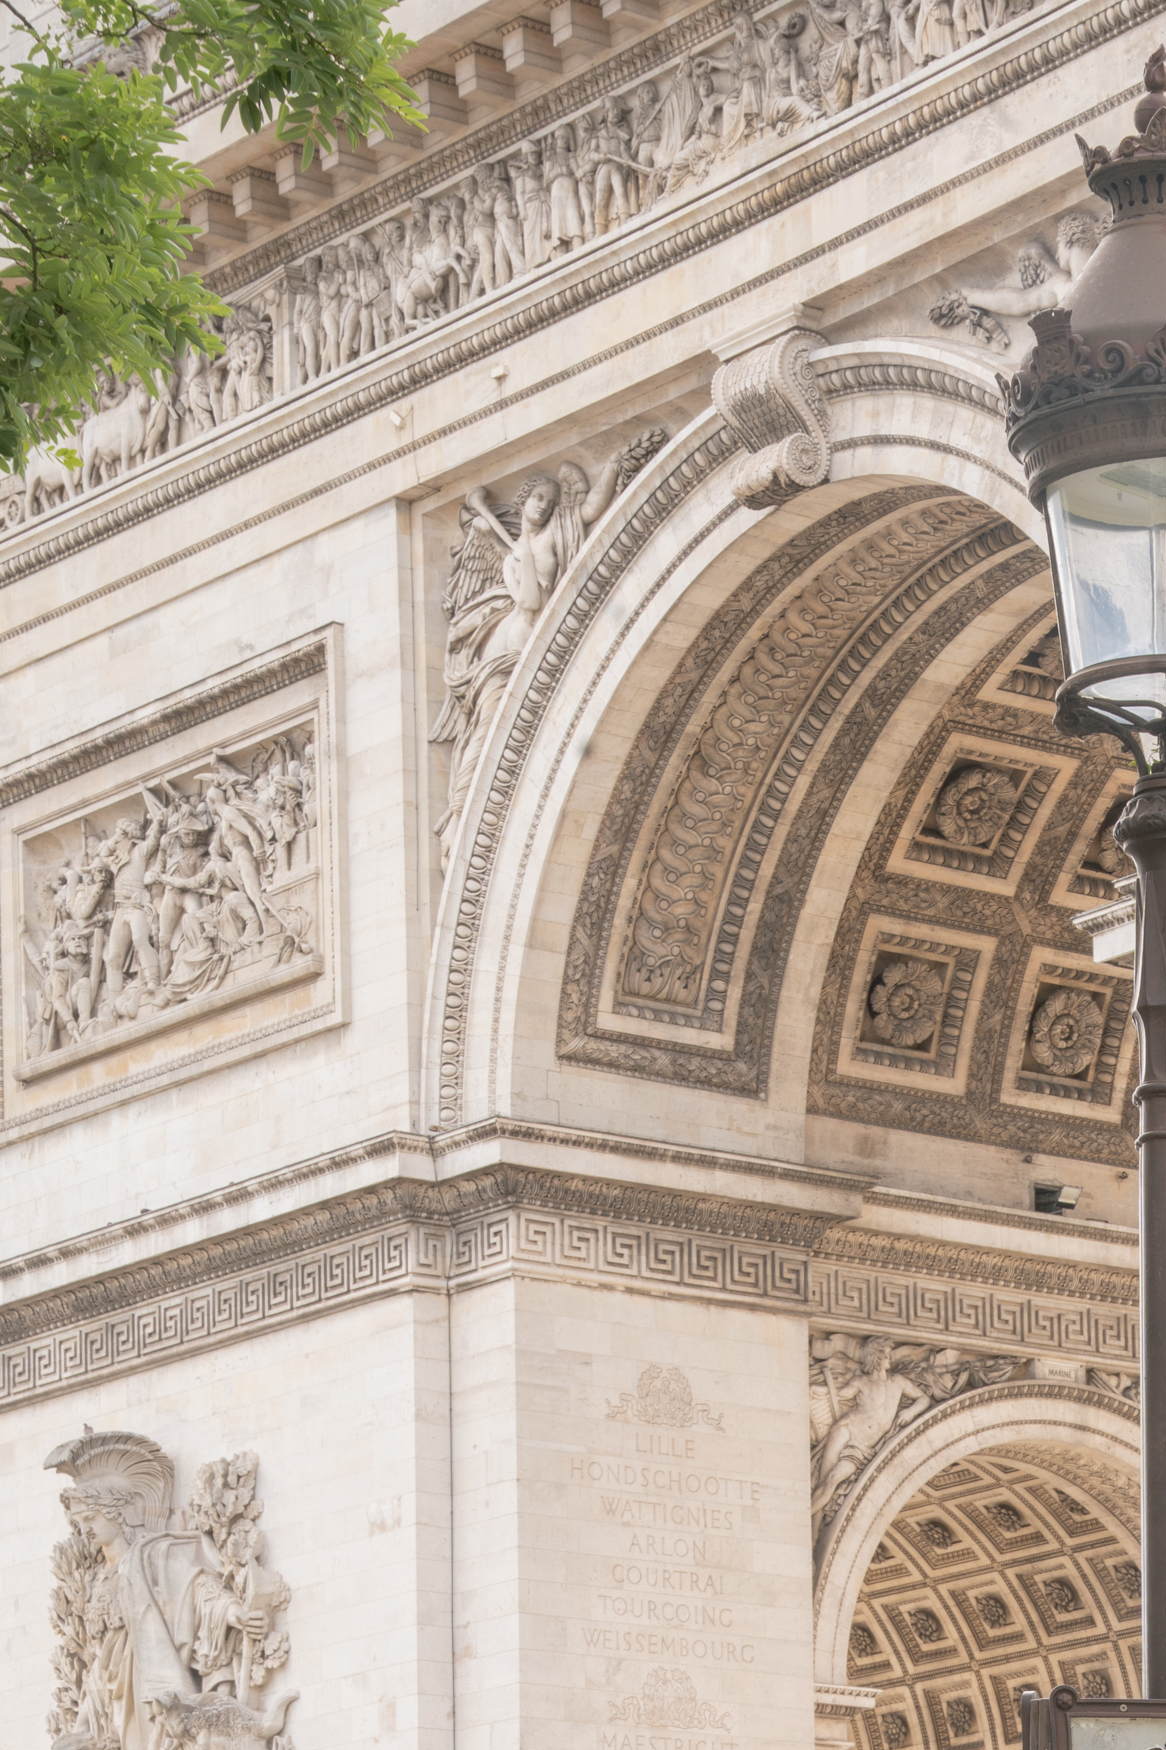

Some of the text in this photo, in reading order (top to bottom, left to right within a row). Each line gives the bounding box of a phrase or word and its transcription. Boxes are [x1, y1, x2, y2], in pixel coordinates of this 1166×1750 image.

[1048, 1368, 1072, 1378] MARINE
[635, 1433, 695, 1459] LILLE
[570, 1458, 761, 1501] HONDSCHOOTTE
[600, 1495, 733, 1531] WATTIGNIES
[628, 1533, 706, 1561] ARLON
[612, 1564, 724, 1595] COURTRAI
[598, 1594, 733, 1628] TOURCOING
[582, 1627, 755, 1664] WEISSEMBOURG
